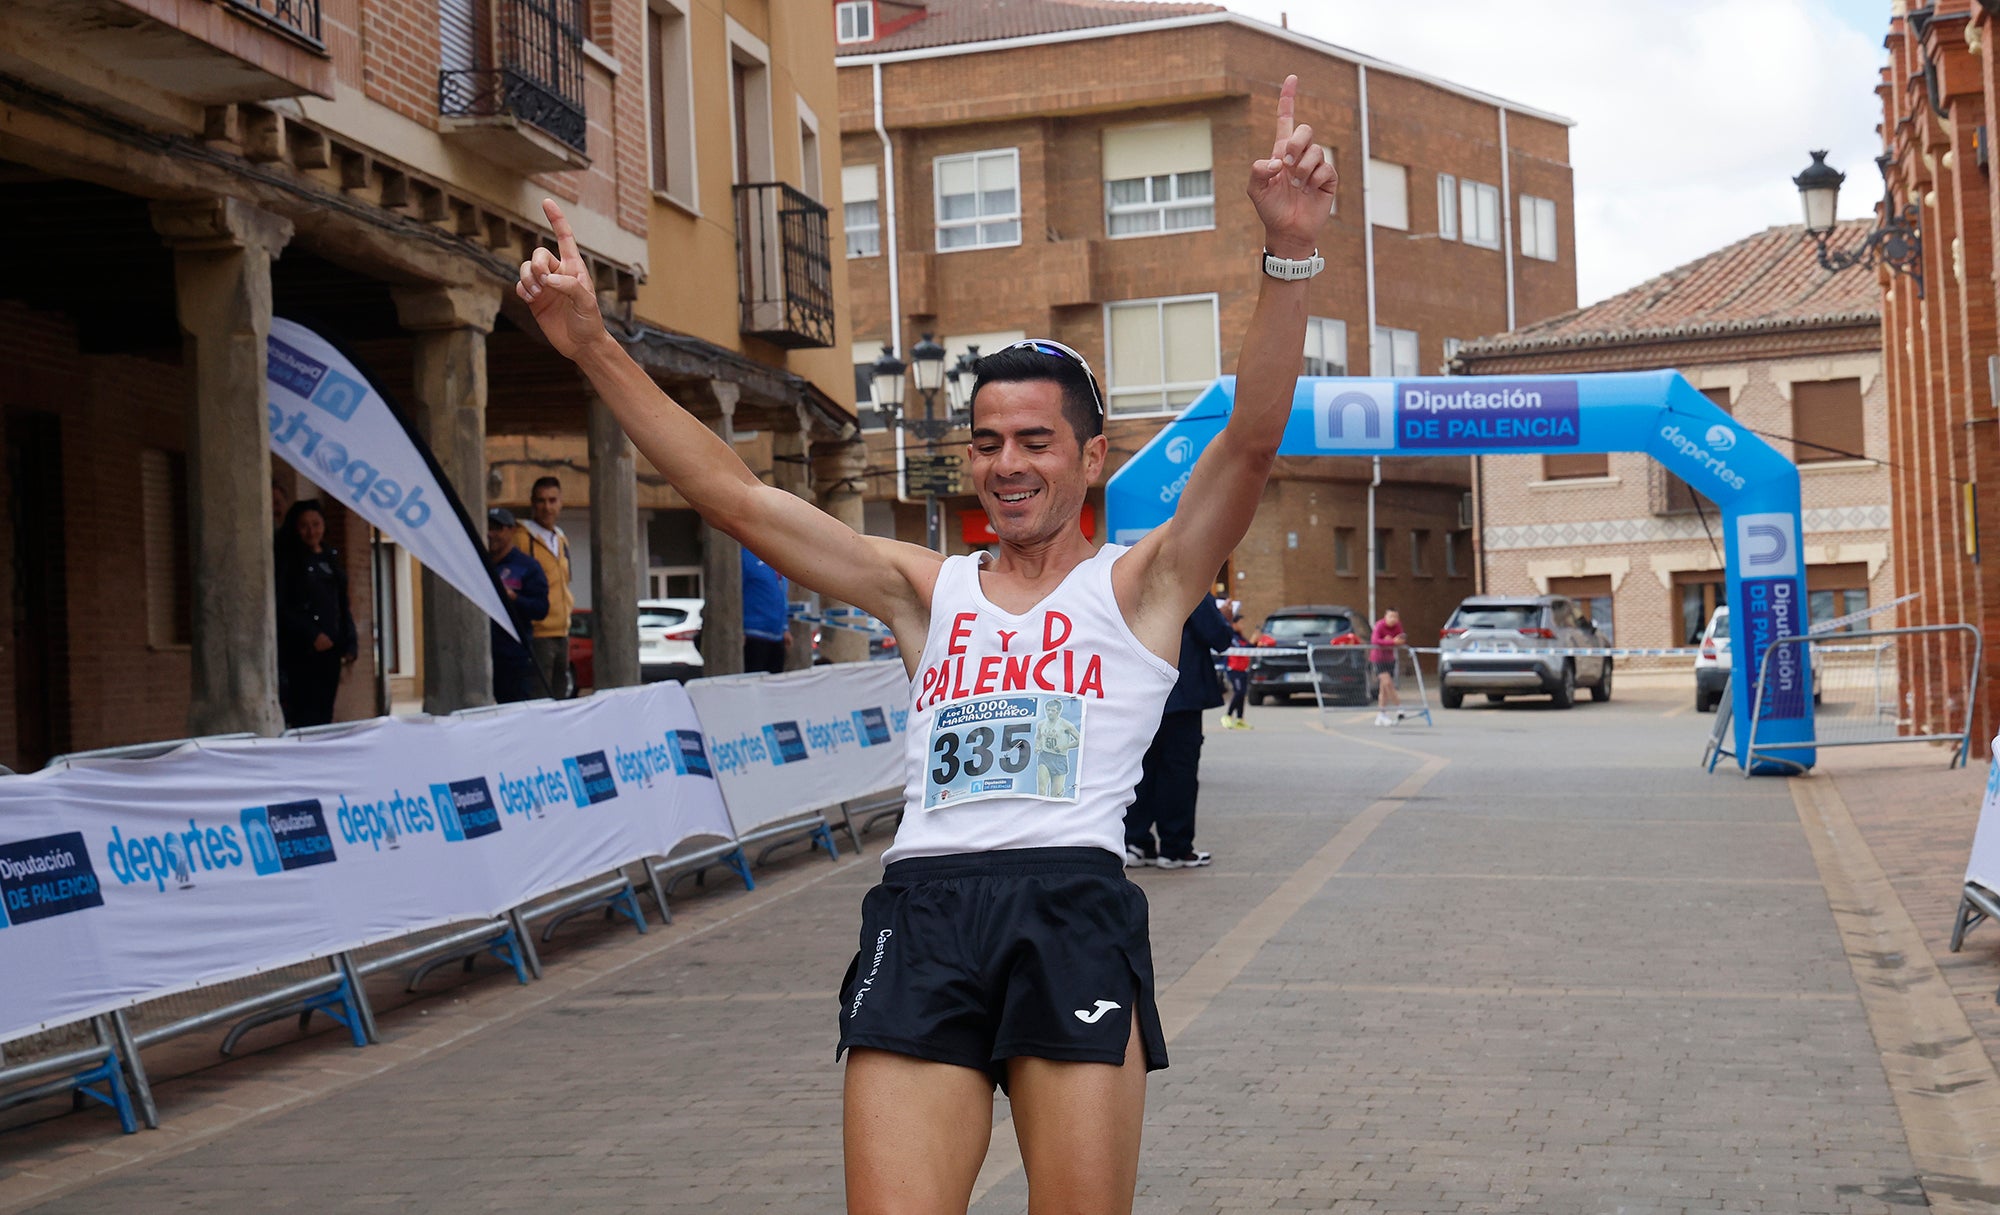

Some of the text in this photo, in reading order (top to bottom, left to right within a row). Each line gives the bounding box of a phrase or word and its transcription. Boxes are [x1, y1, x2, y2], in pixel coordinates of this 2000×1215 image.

[1405, 389, 1542, 414] Diputación
[1406, 417, 1576, 440] DE PALENCIA
[1660, 425, 1746, 490] deportes
[1160, 462, 1197, 503] dep
[1750, 584, 1767, 612] DE
[948, 612, 977, 656] E
[1043, 611, 1072, 651] D
[916, 650, 1104, 712] PALENCIA
[942, 708, 1029, 727] MARIANO HARO
[961, 700, 1008, 715] 10.000
[932, 723, 1032, 785] 335
[499, 765, 569, 820] deportes
[337, 789, 435, 852] deportes
[0, 848, 76, 882] Diputación
[107, 818, 244, 892] deportes
[7, 874, 98, 911] DE PALENCIA
